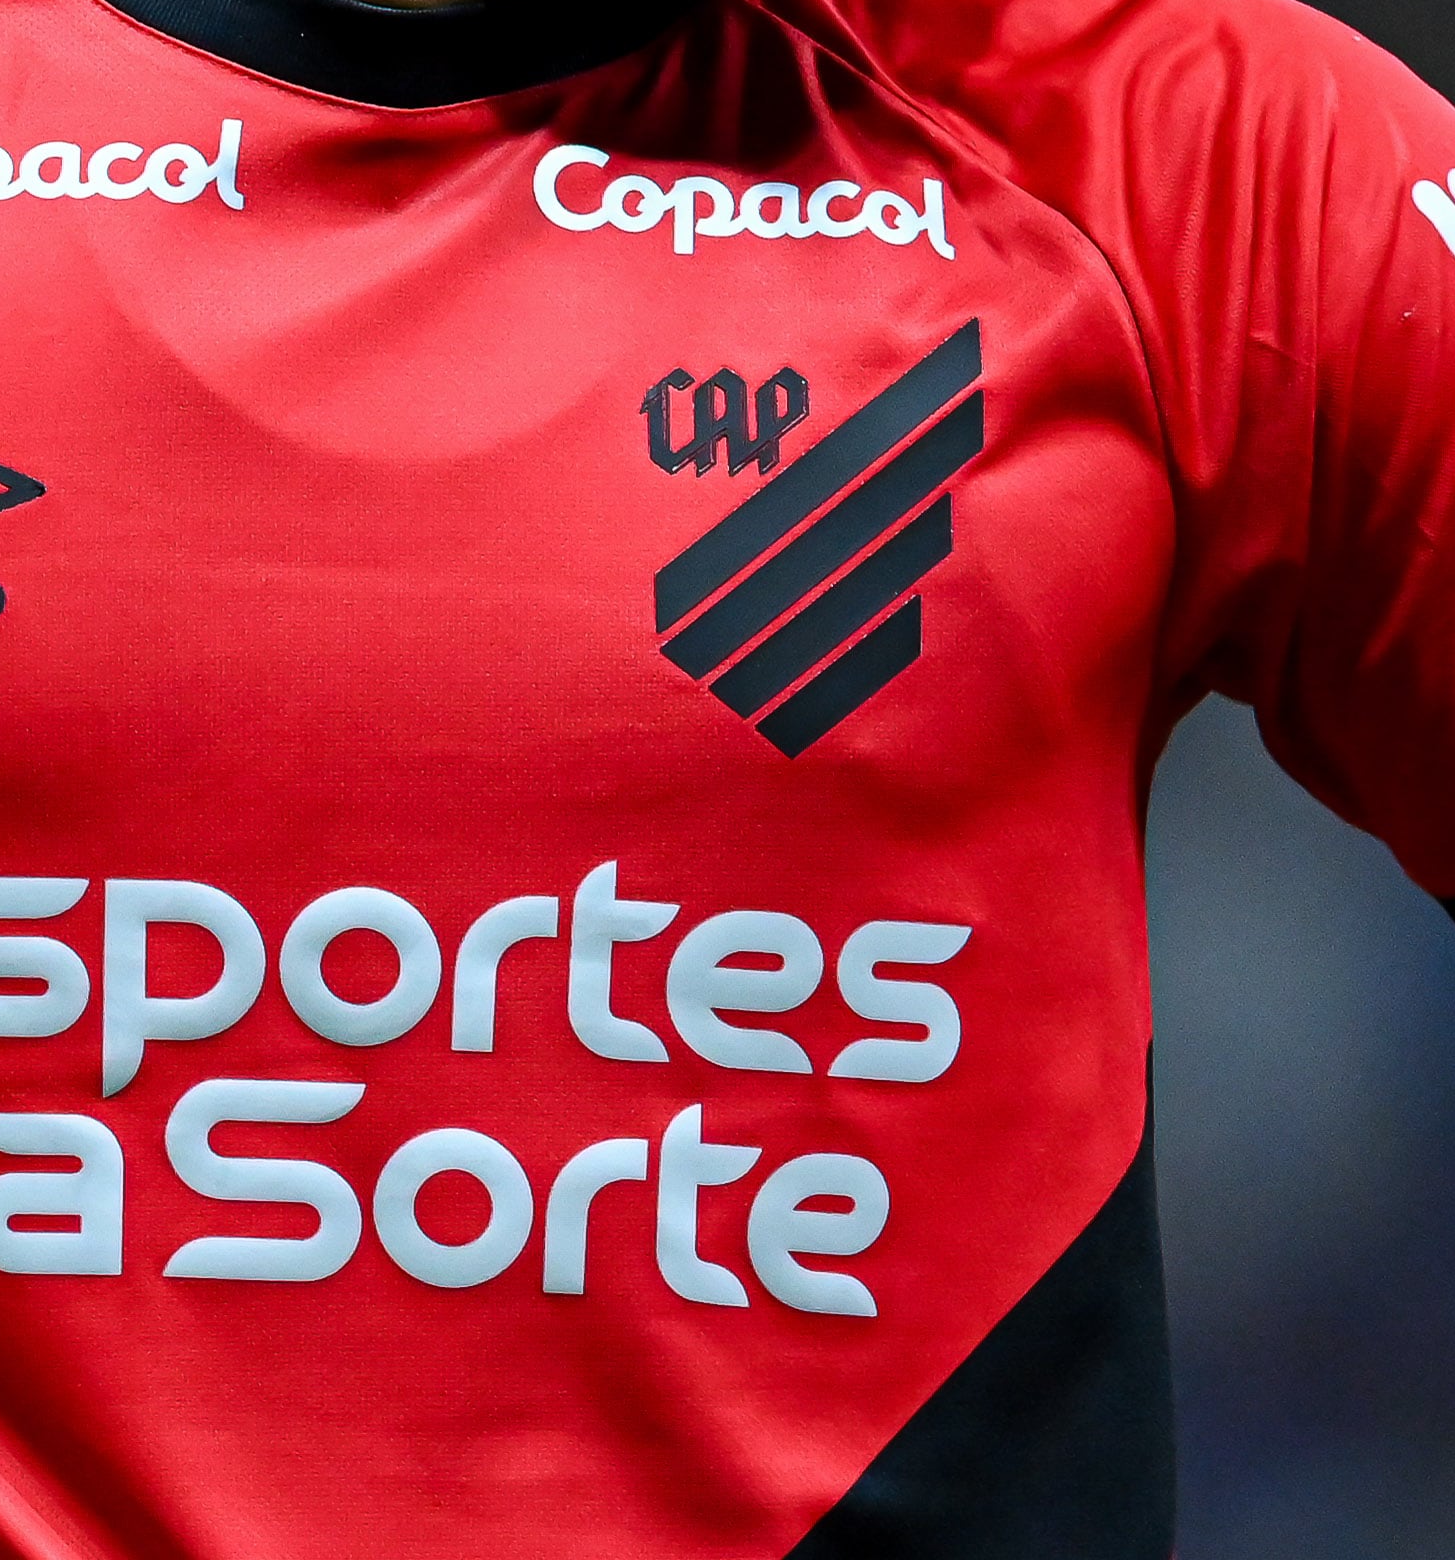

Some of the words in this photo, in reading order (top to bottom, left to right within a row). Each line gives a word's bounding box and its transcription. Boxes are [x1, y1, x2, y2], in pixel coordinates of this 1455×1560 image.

[532, 143, 956, 261] Copacol
[640, 366, 810, 478] CAP
[161, 1077, 892, 1318] Sorte
